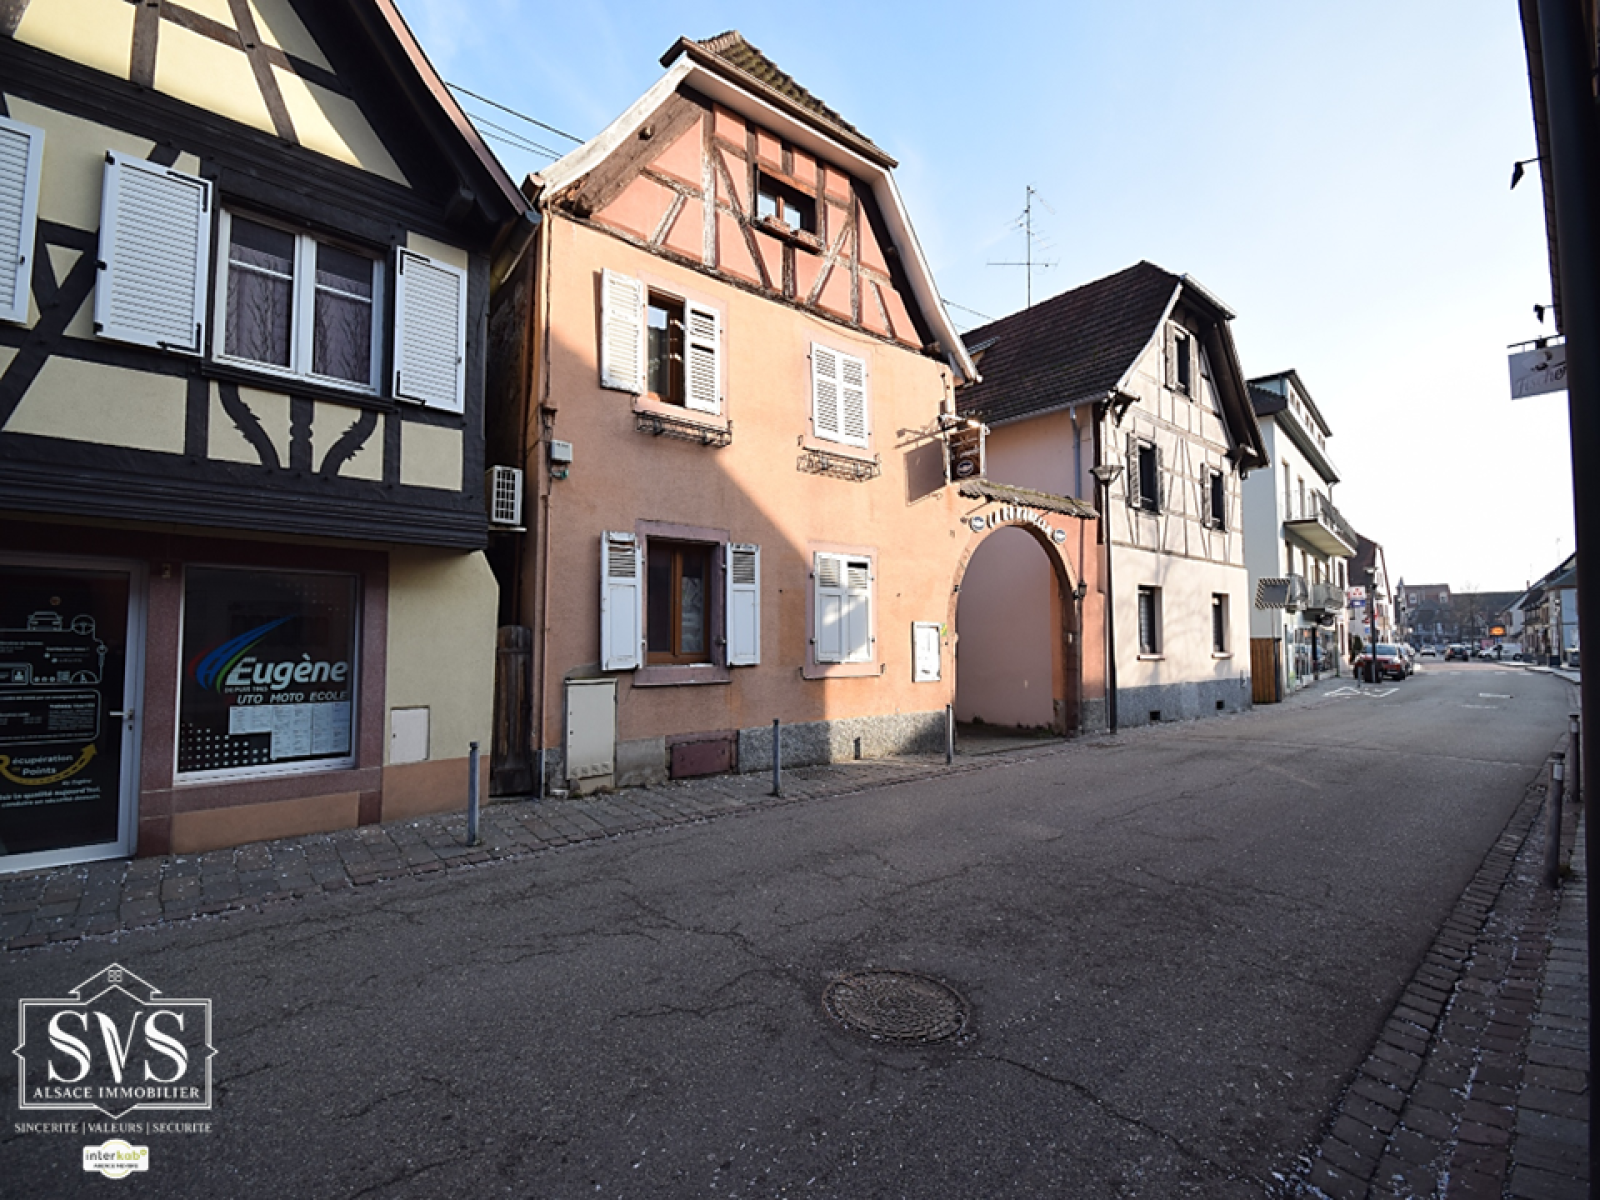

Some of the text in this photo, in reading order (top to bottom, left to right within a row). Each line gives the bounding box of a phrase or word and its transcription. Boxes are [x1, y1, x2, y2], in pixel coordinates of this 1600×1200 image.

[225, 652, 348, 691] Eugène
[270, 692, 305, 704] MOTO
[309, 690, 348, 702] ECOLE
